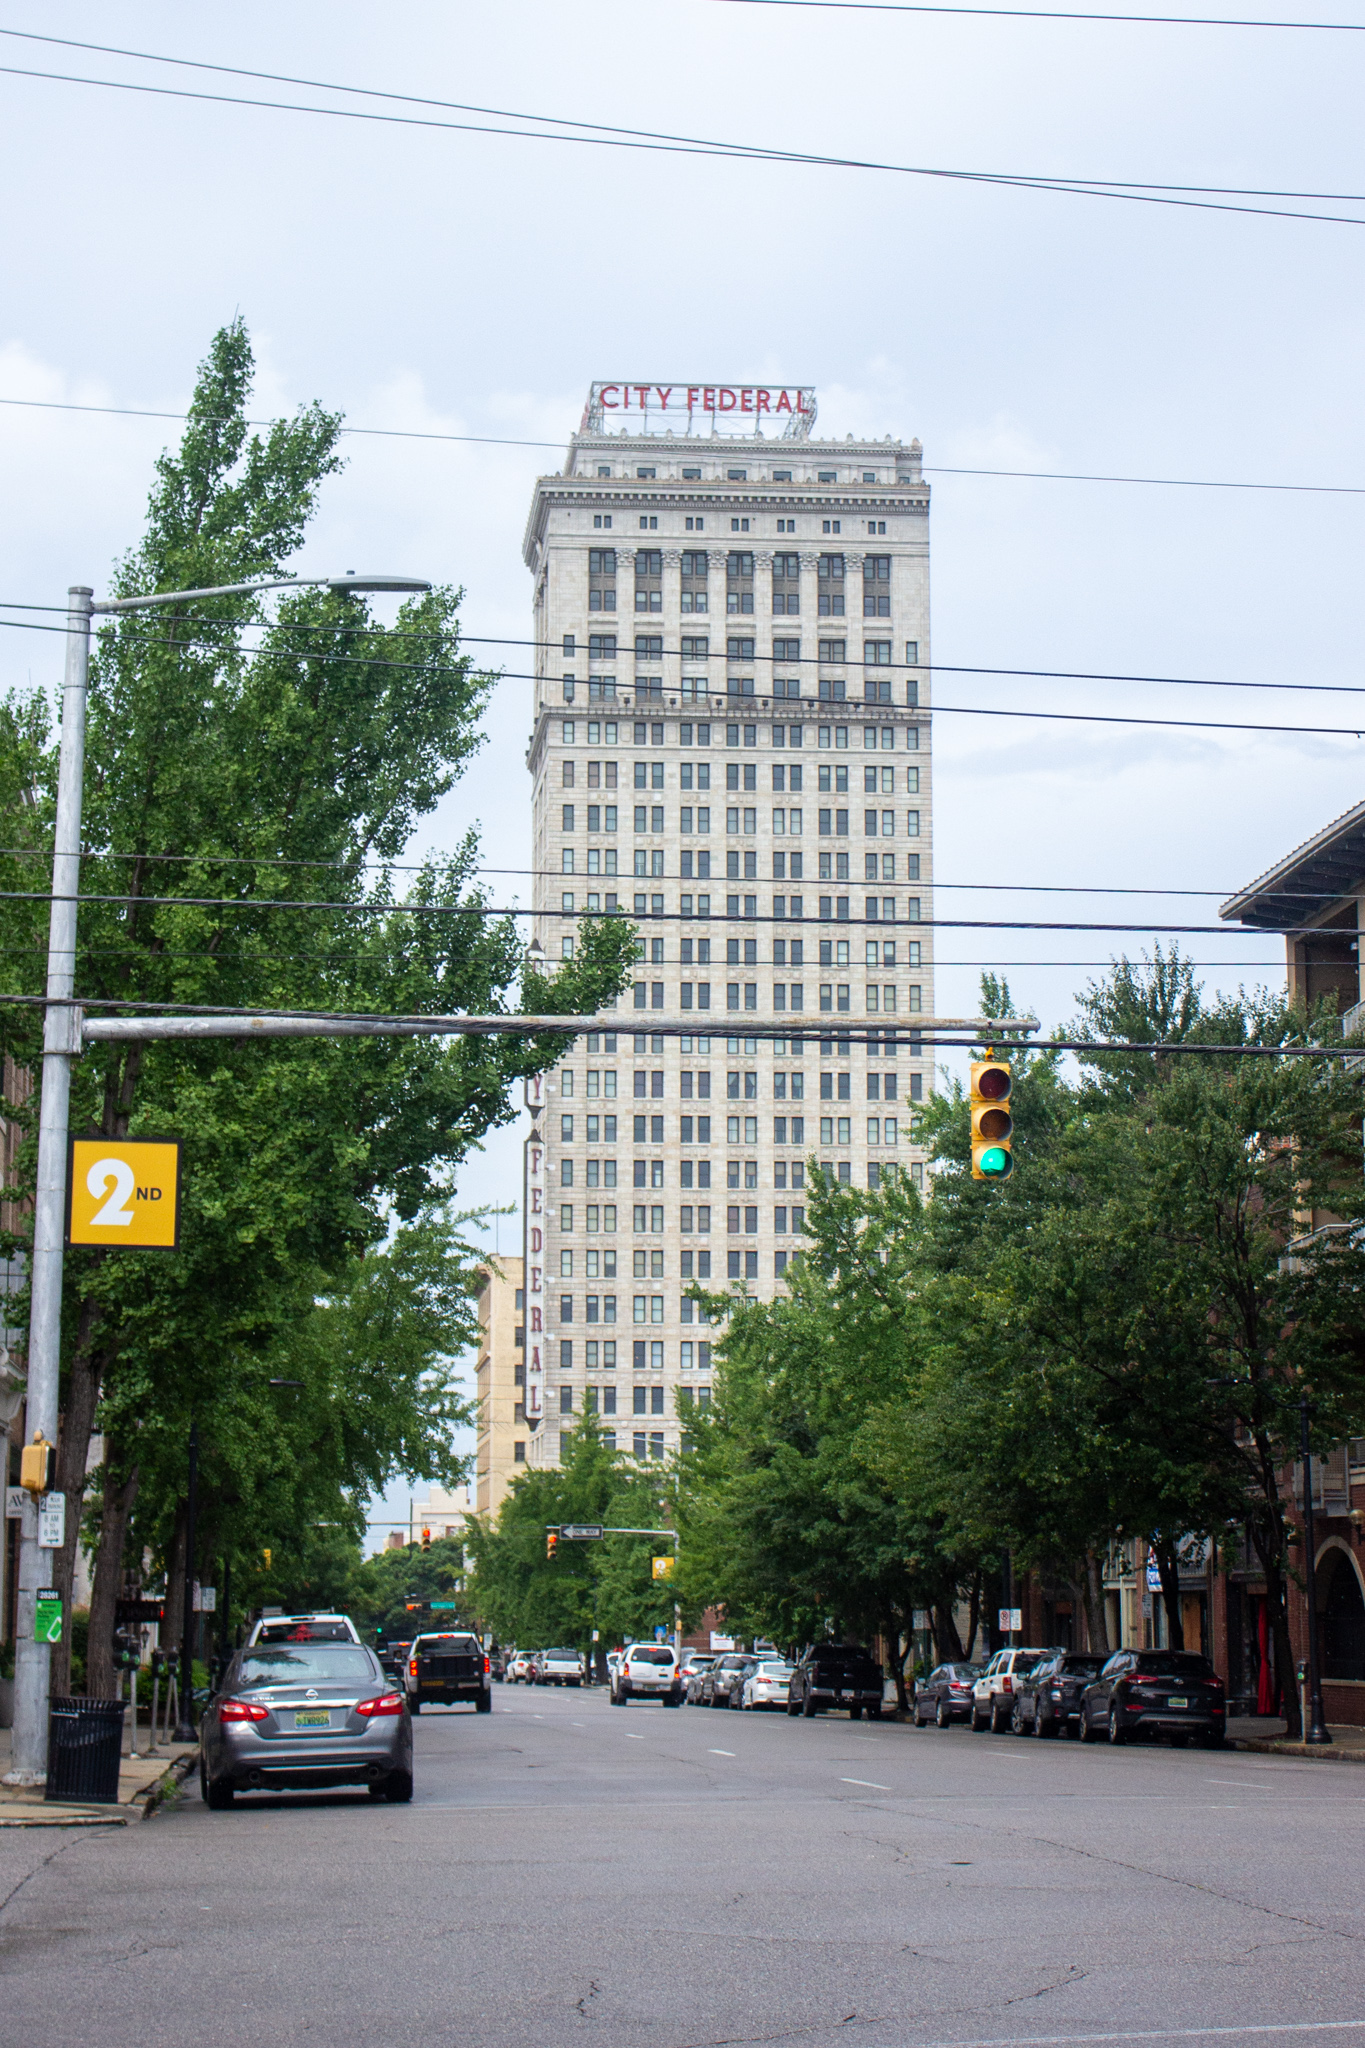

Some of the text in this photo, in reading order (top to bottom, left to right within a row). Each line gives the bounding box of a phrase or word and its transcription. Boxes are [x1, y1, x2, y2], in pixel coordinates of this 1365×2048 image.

[600, 386, 810, 413] CITY FEDERAL
[531, 1148, 542, 1412] FEDERAL
[41, 1497, 46, 1510] 2
